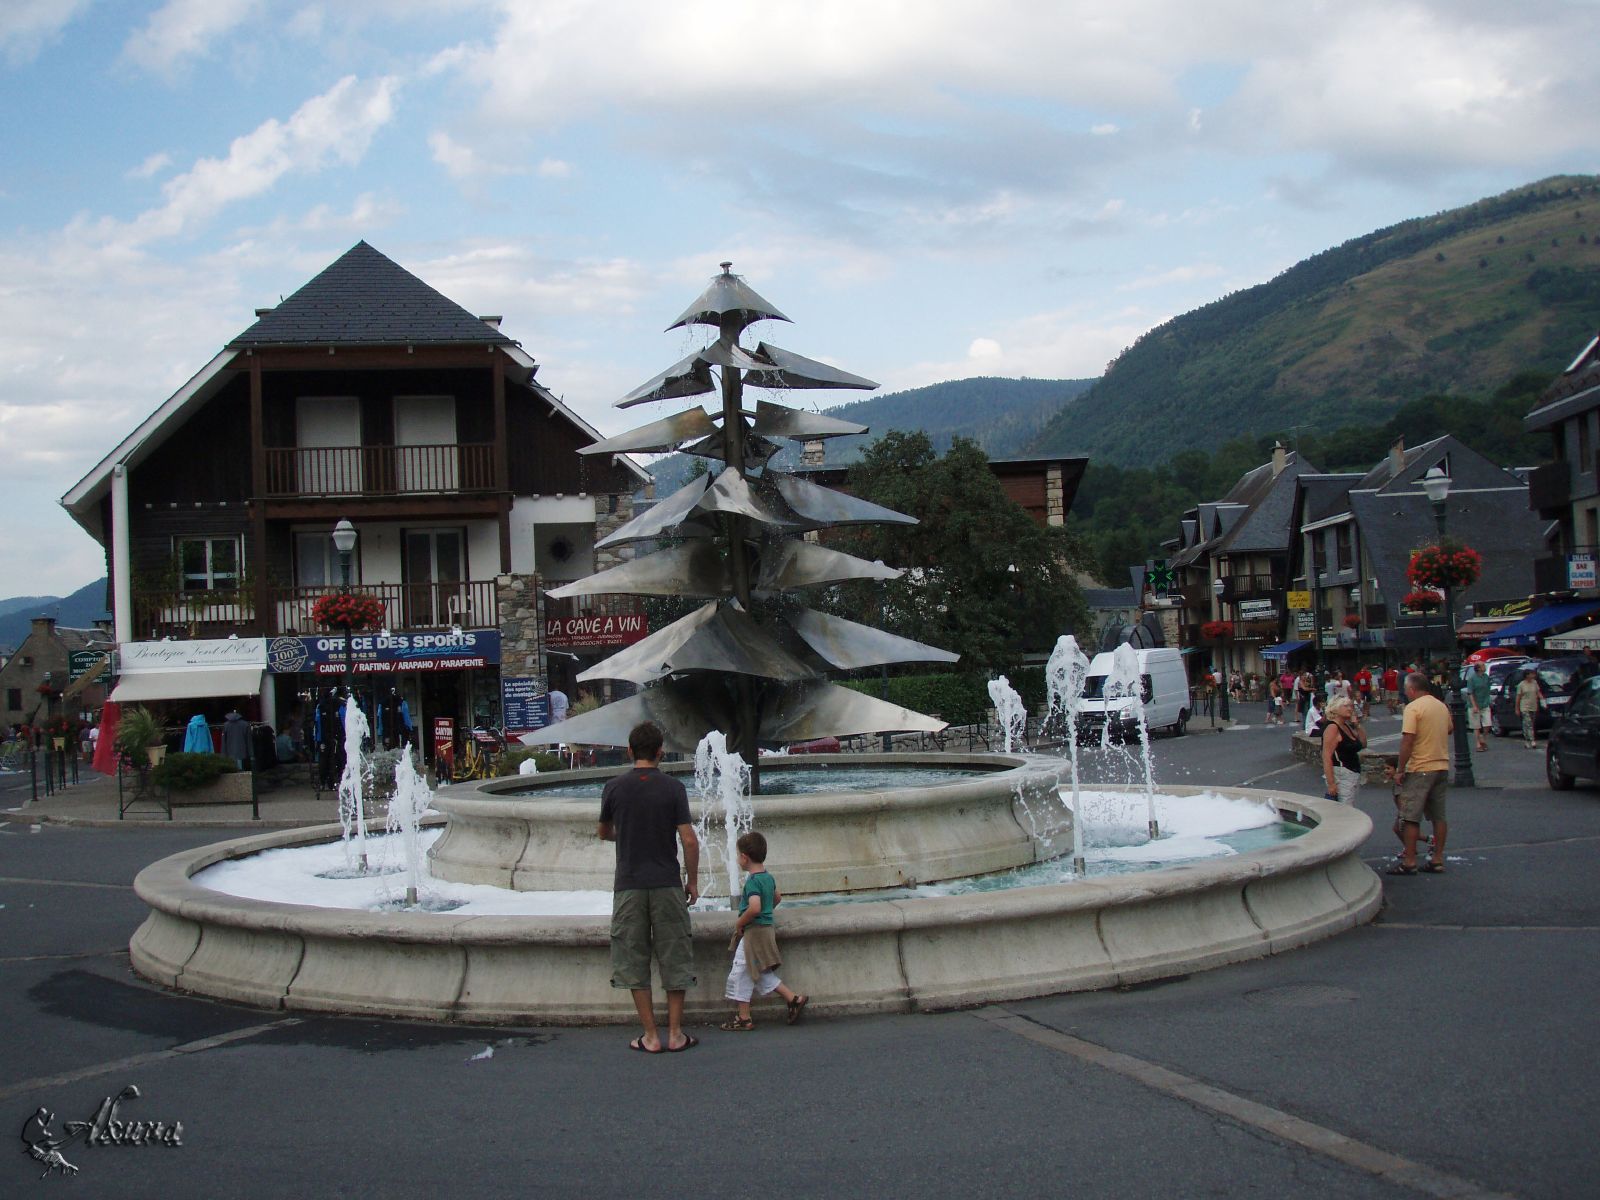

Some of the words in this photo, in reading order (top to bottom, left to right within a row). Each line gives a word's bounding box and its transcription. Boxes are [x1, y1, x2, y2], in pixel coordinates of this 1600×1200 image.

[547, 619, 561, 635] LA
[566, 618, 600, 635] CAVE
[604, 617, 613, 633] A
[618, 616, 641, 632] VIN
[317, 637, 372, 651] OFFCE
[376, 636, 409, 649] DES
[413, 633, 476, 648] SPORTS
[320, 664, 347, 673] CANYO
[359, 662, 390, 671] RAFTING
[398, 660, 433, 670] ARAPAHO
[440, 659, 484, 668] PARAPENTE
